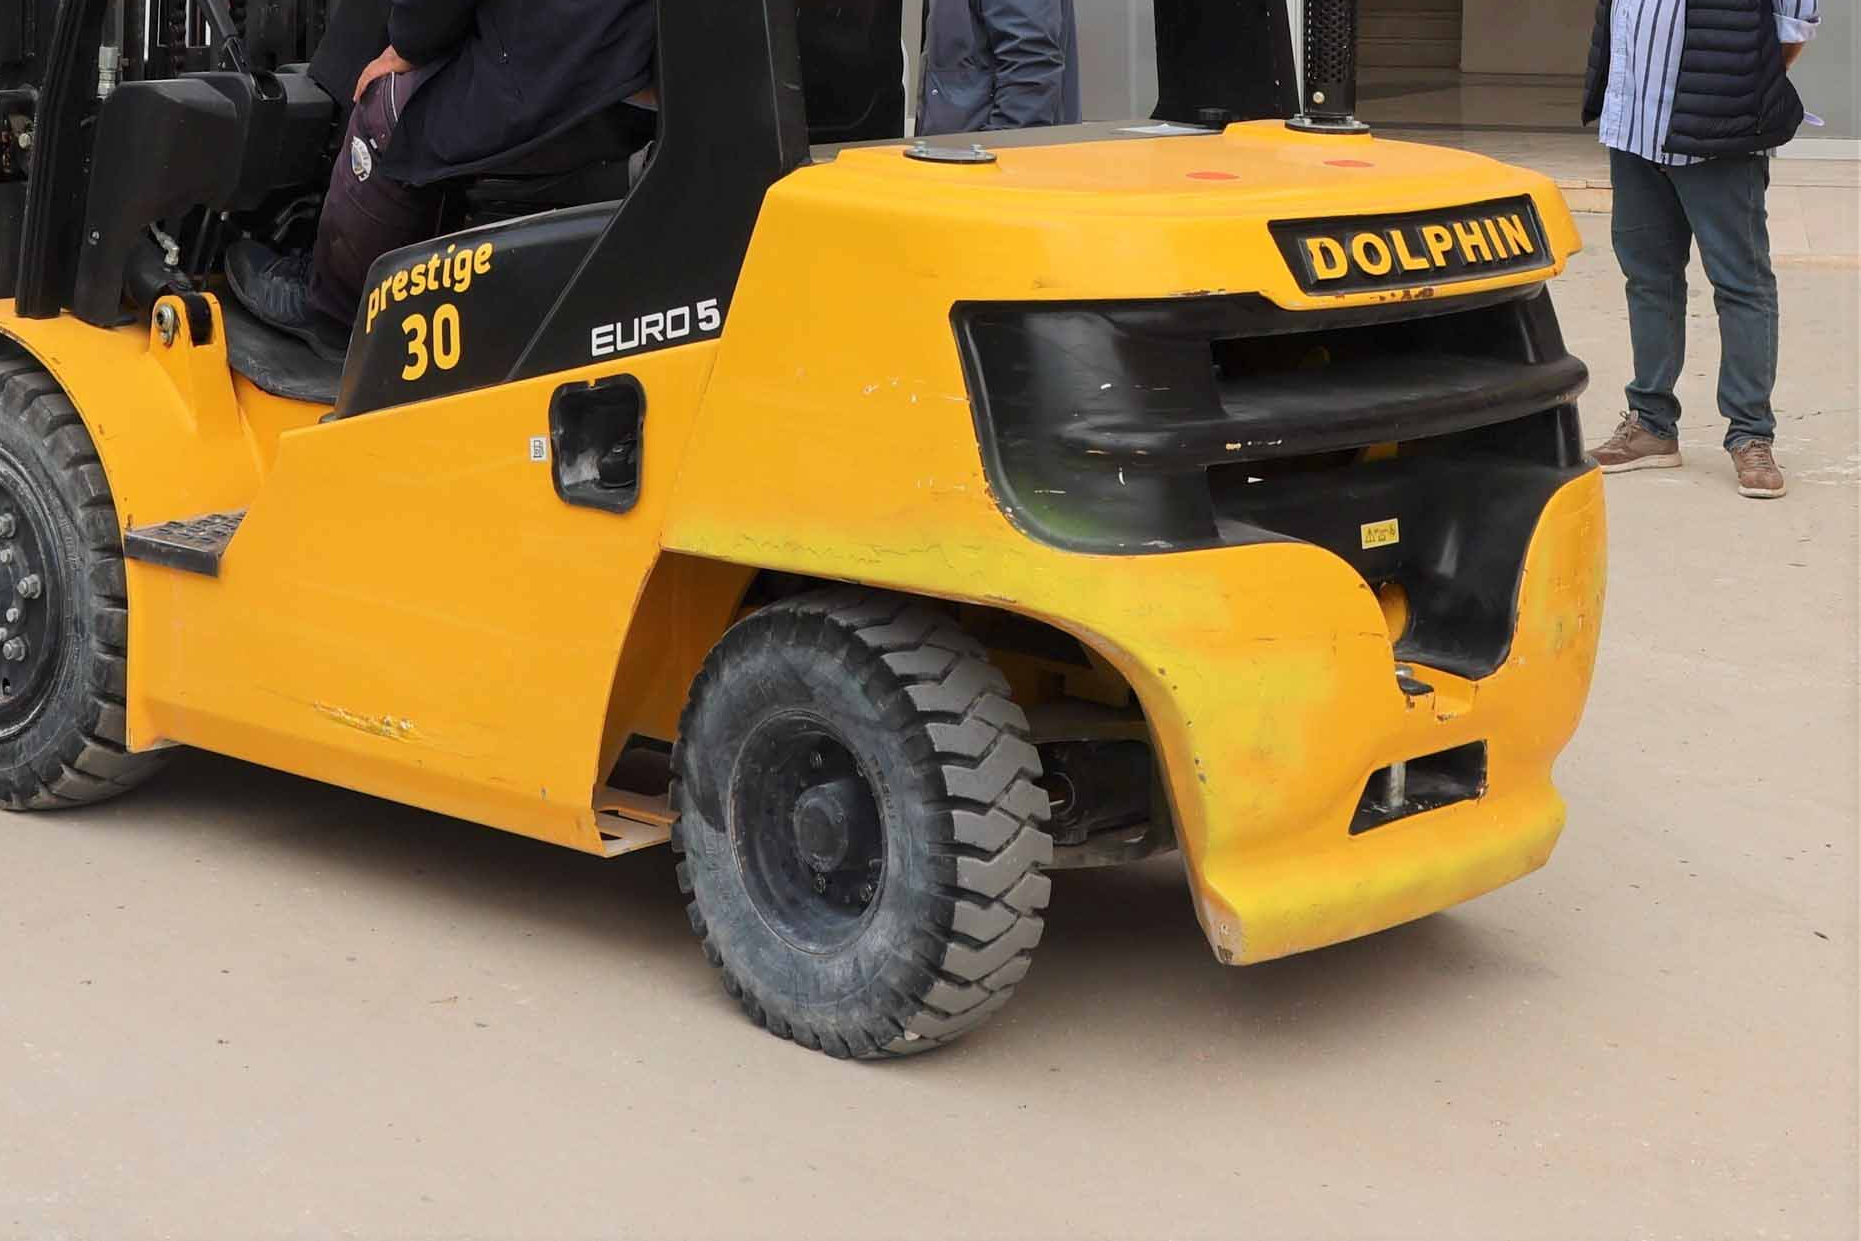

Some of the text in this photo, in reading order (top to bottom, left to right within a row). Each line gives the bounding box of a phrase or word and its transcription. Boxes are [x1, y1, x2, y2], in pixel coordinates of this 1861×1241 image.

[1305, 214, 1534, 281] DOLPHIN
[365, 242, 493, 334] prestige
[401, 303, 461, 382] 30
[591, 298, 721, 357] EURO 5
